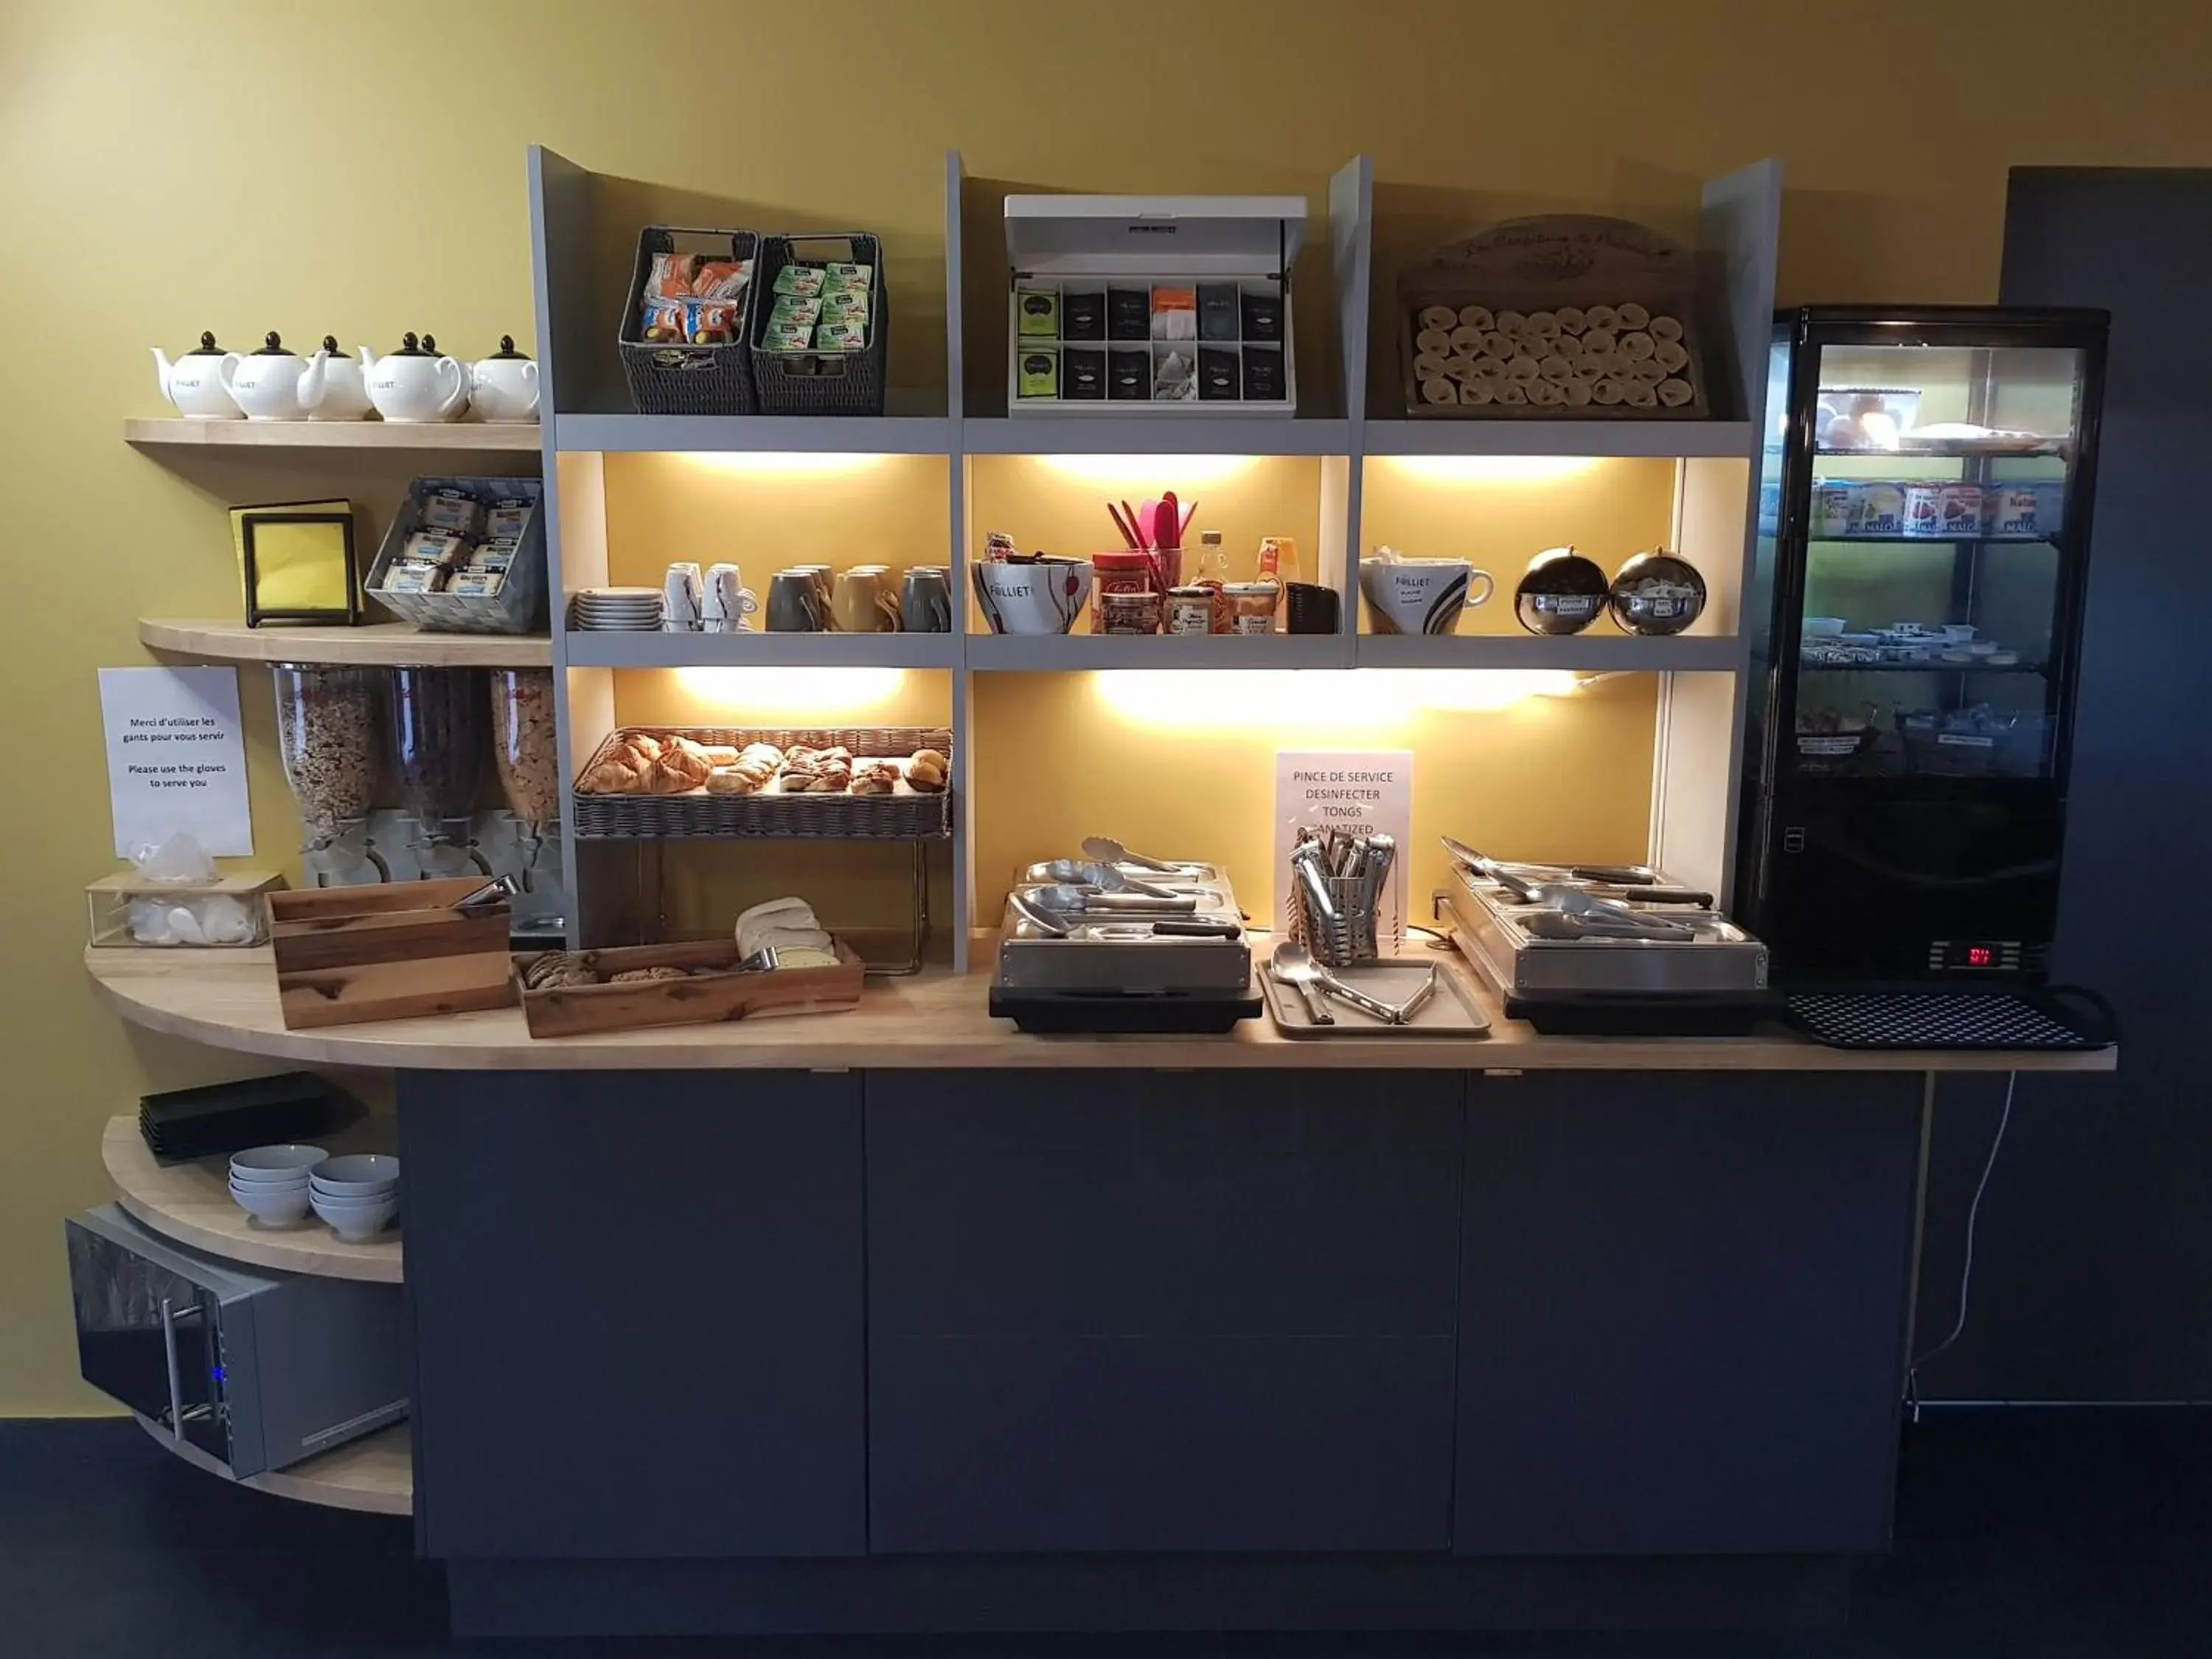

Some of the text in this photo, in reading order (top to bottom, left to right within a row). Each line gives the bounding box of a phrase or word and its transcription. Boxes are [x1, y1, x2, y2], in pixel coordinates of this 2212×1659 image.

[131, 716, 215, 727] Merci d'utiliser les
[123, 731, 224, 744] gants pour vous servir
[128, 762, 226, 773] Please use the gloves
[1293, 771, 1394, 782] PINCE DE SERVICE
[150, 779, 207, 788] to serve you
[1306, 789, 1380, 800] DESINFECTER
[1322, 806, 1362, 818] TONGS
[1314, 824, 1374, 835] ANATIZED
